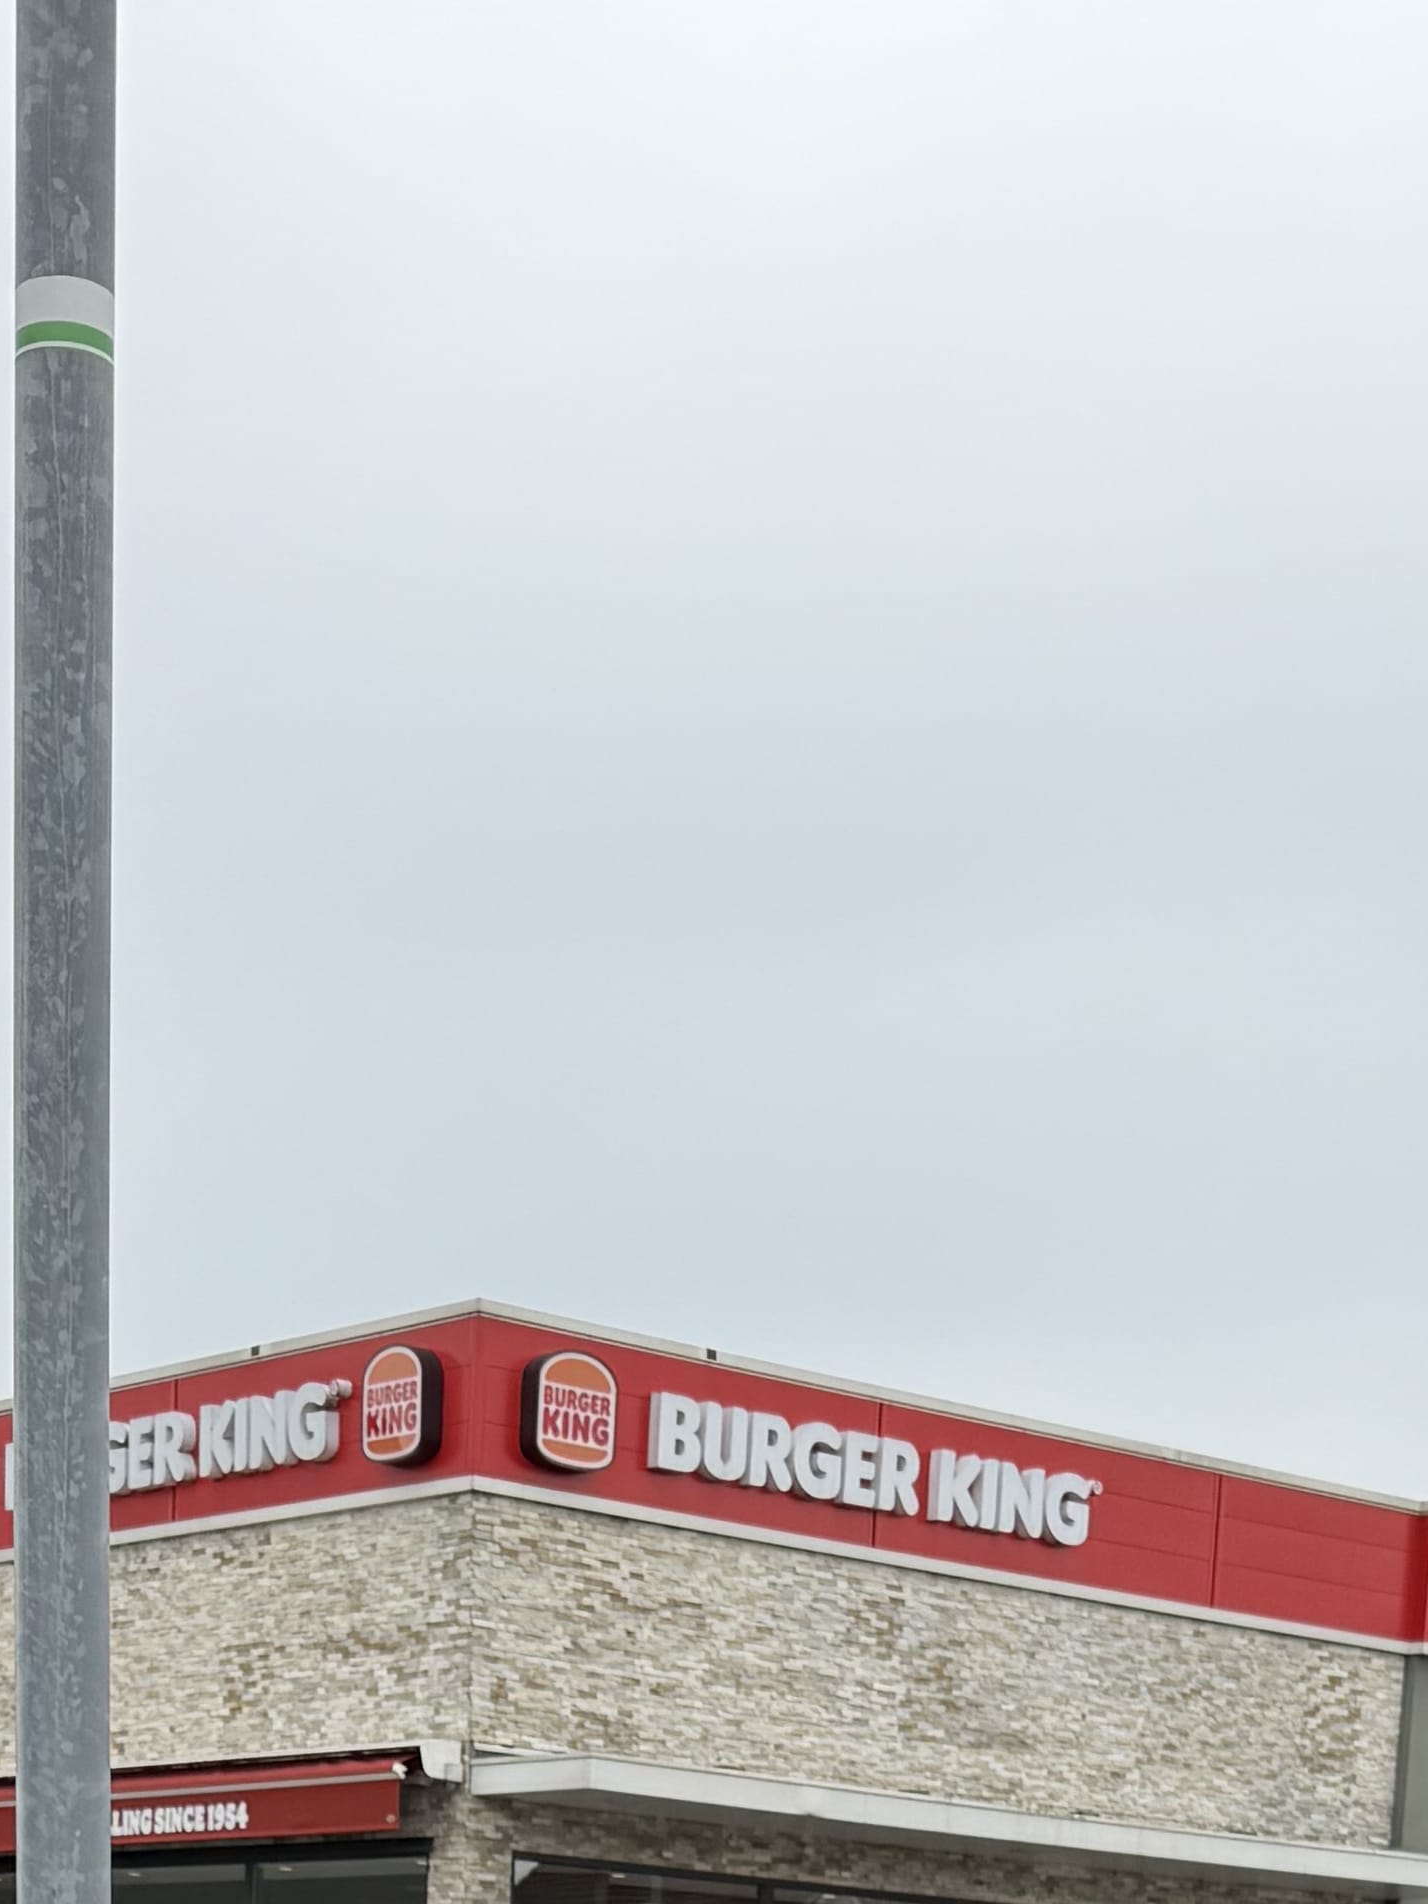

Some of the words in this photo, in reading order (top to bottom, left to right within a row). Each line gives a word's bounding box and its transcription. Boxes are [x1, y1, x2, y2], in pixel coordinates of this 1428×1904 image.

[367, 1381, 418, 1409] BURGER
[543, 1385, 611, 1417] BURGER
[199, 1381, 340, 1479] KING
[367, 1402, 417, 1438] KING
[542, 1406, 610, 1447] KING
[649, 1392, 920, 1517] BURGER
[928, 1448, 1090, 1546] KING
[154, 1805, 206, 1834] SINCE
[207, 1801, 249, 1831] 1954
